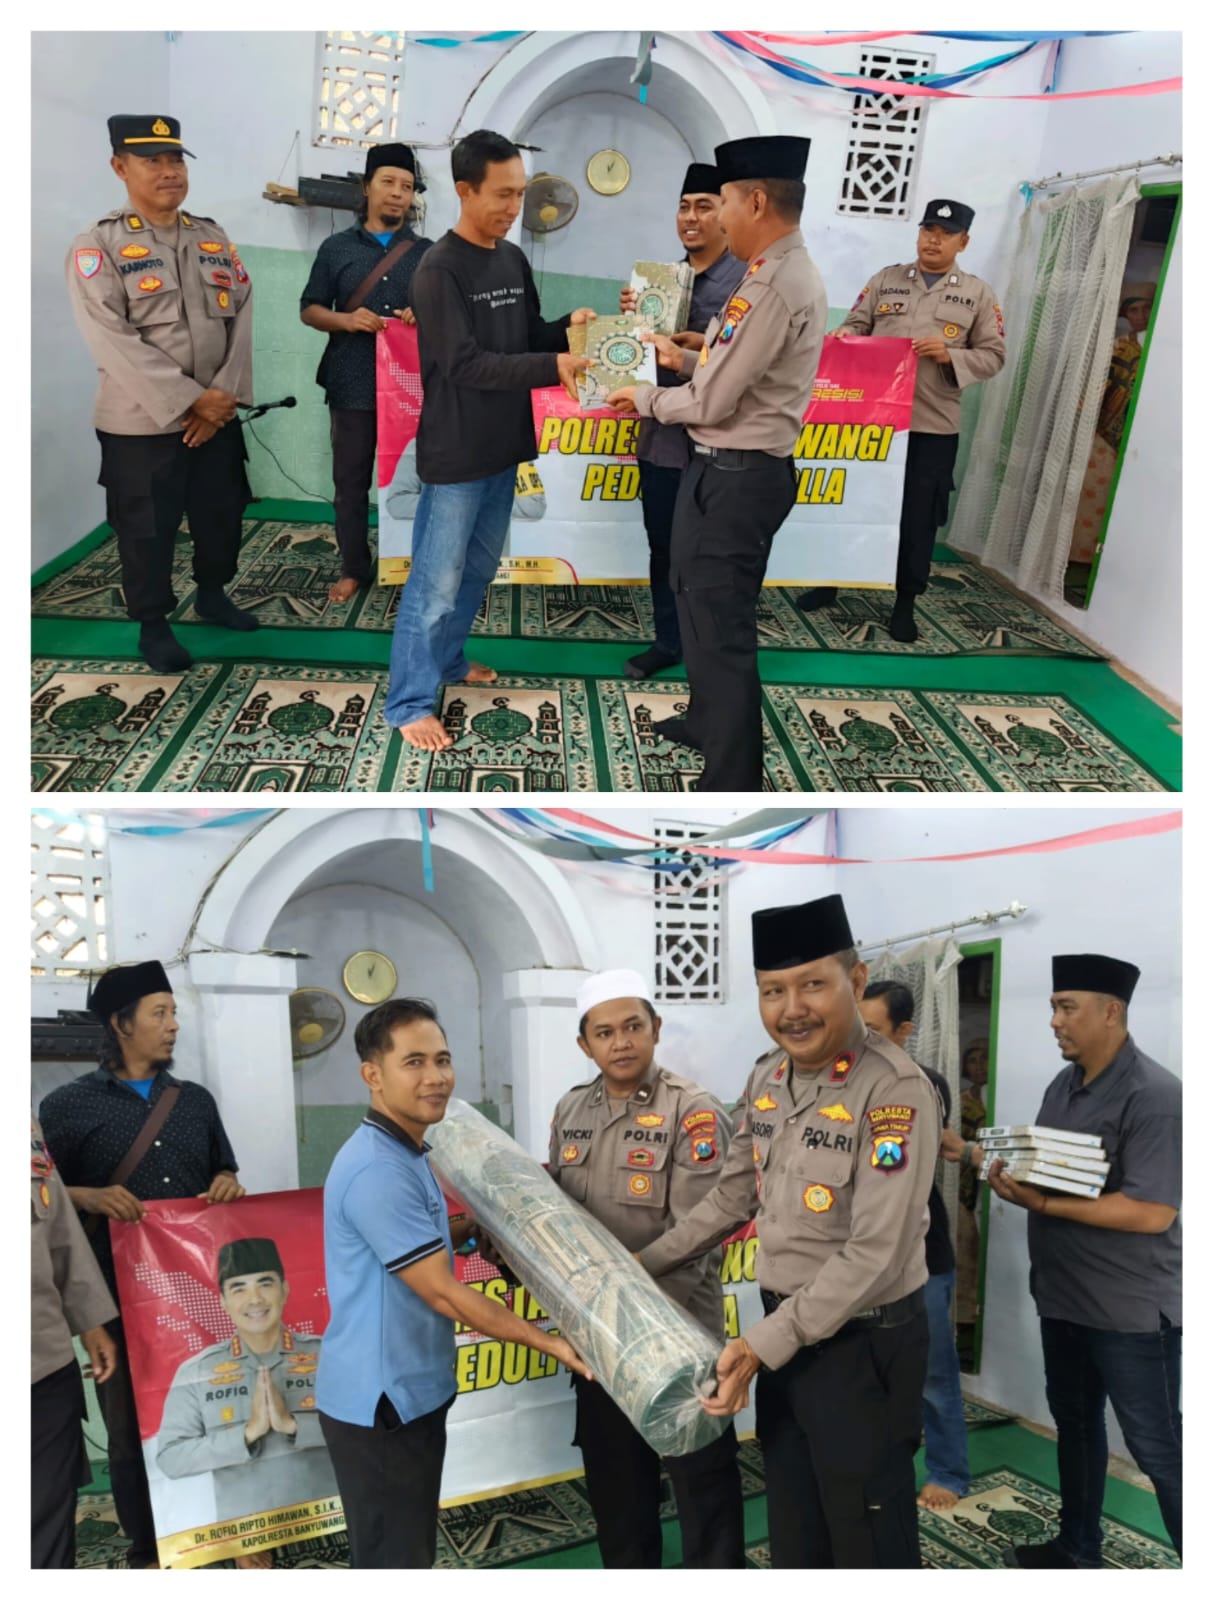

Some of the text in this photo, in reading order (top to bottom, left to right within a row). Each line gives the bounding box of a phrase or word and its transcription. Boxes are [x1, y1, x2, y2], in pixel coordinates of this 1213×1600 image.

[198, 255, 231, 267] POLRI
[945, 295, 975, 308] POLRI
[793, 423, 894, 461] WANGI
[581, 463, 846, 504] PED LLA
[562, 1129, 593, 1140] VICKI
[624, 1129, 668, 1144] POLRI
[801, 1127, 852, 1152] POLRI
[453, 1329, 560, 1394] EDULI
[206, 1386, 249, 1402] ROFIQ
[286, 1378, 314, 1390] POL
[194, 1533, 208, 1544] Dr.
[209, 1525, 238, 1541] ROFIQ
[239, 1517, 266, 1534] RIPTO
[241, 1515, 345, 1549] KAPOLRESTA BANYUWANG
